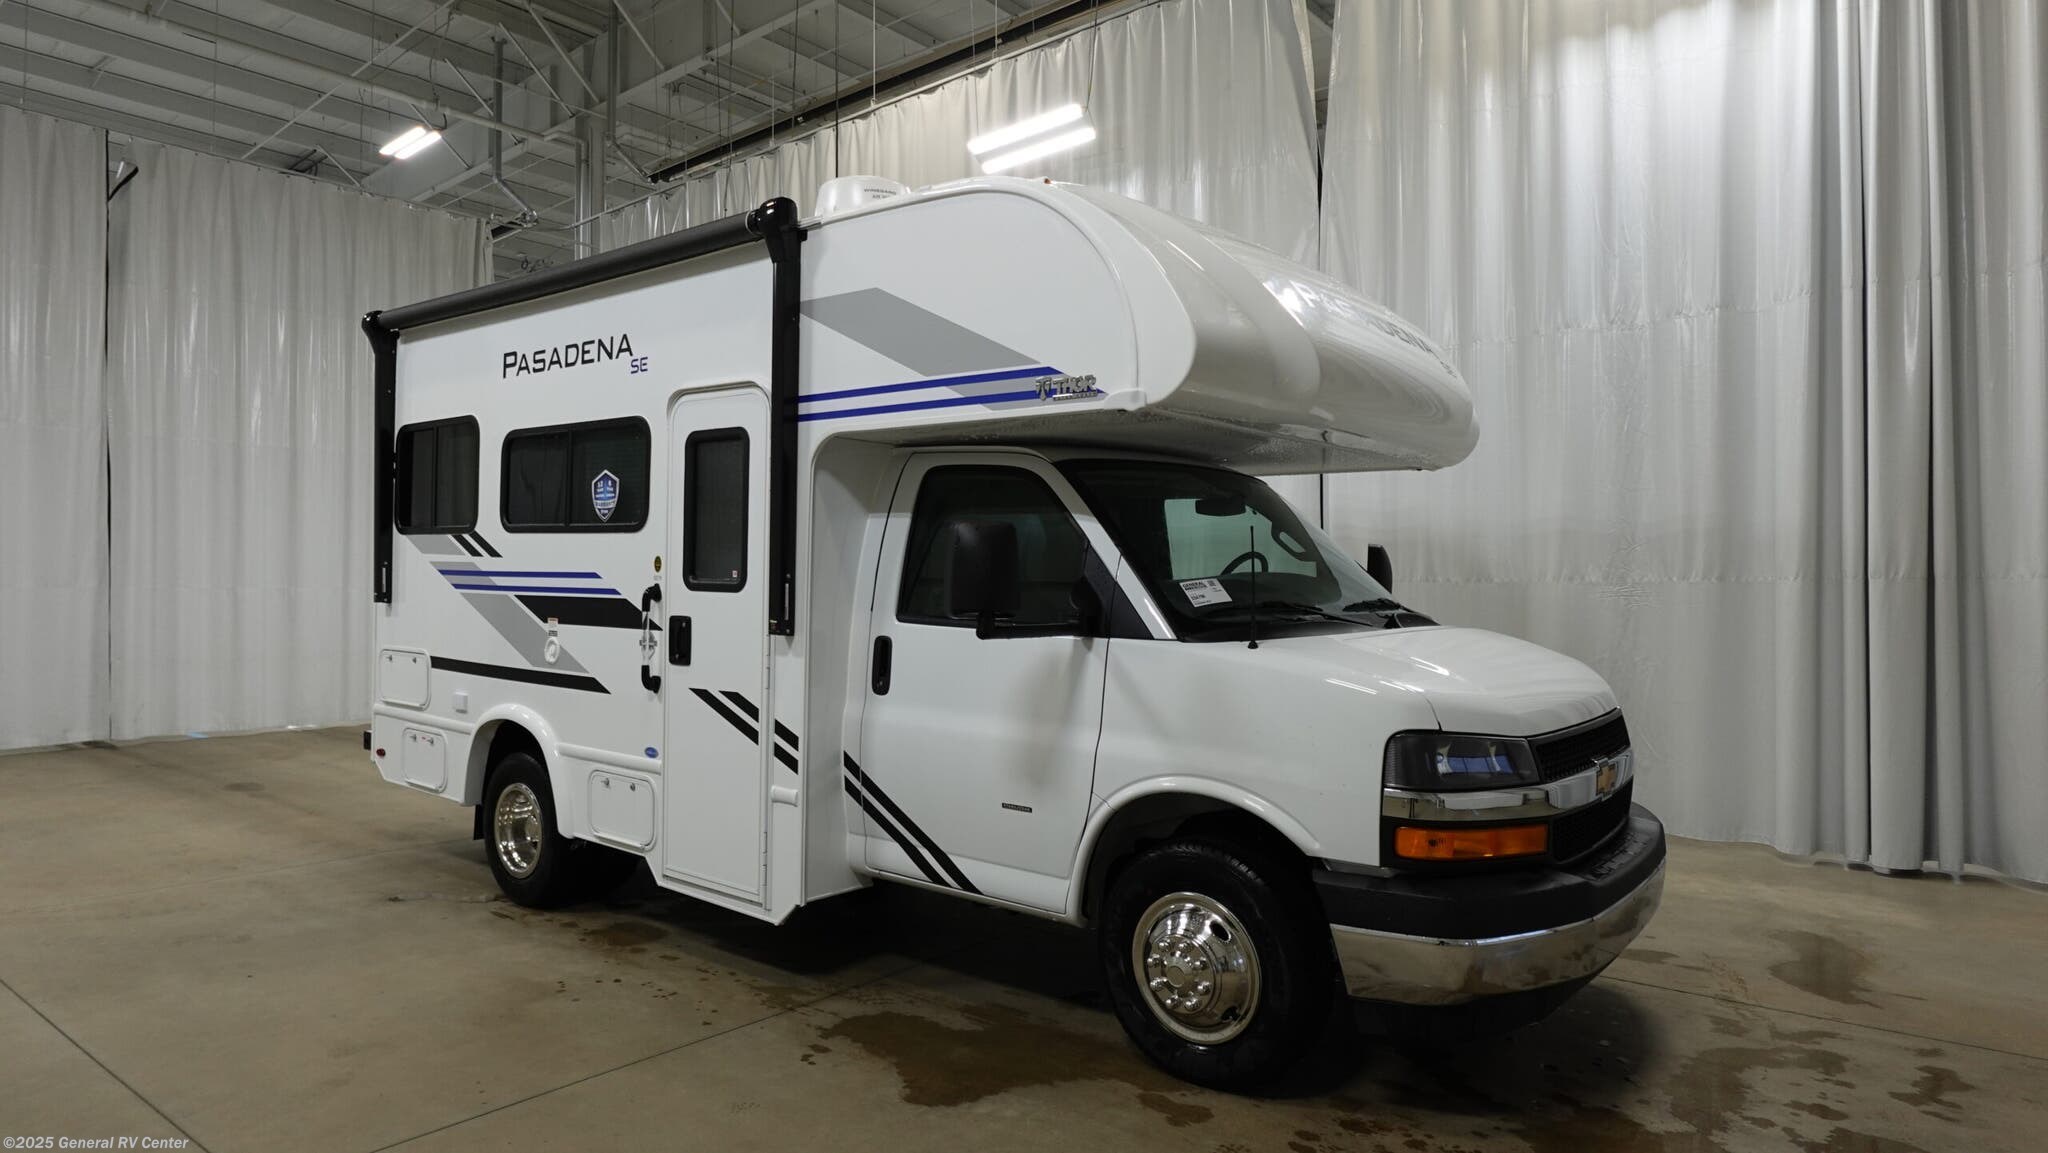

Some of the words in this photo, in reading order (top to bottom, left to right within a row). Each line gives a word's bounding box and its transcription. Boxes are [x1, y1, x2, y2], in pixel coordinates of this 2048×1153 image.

[502, 333, 634, 379] PASADENA
[630, 356, 649, 375] SE
[1052, 374, 1097, 394] THOR
